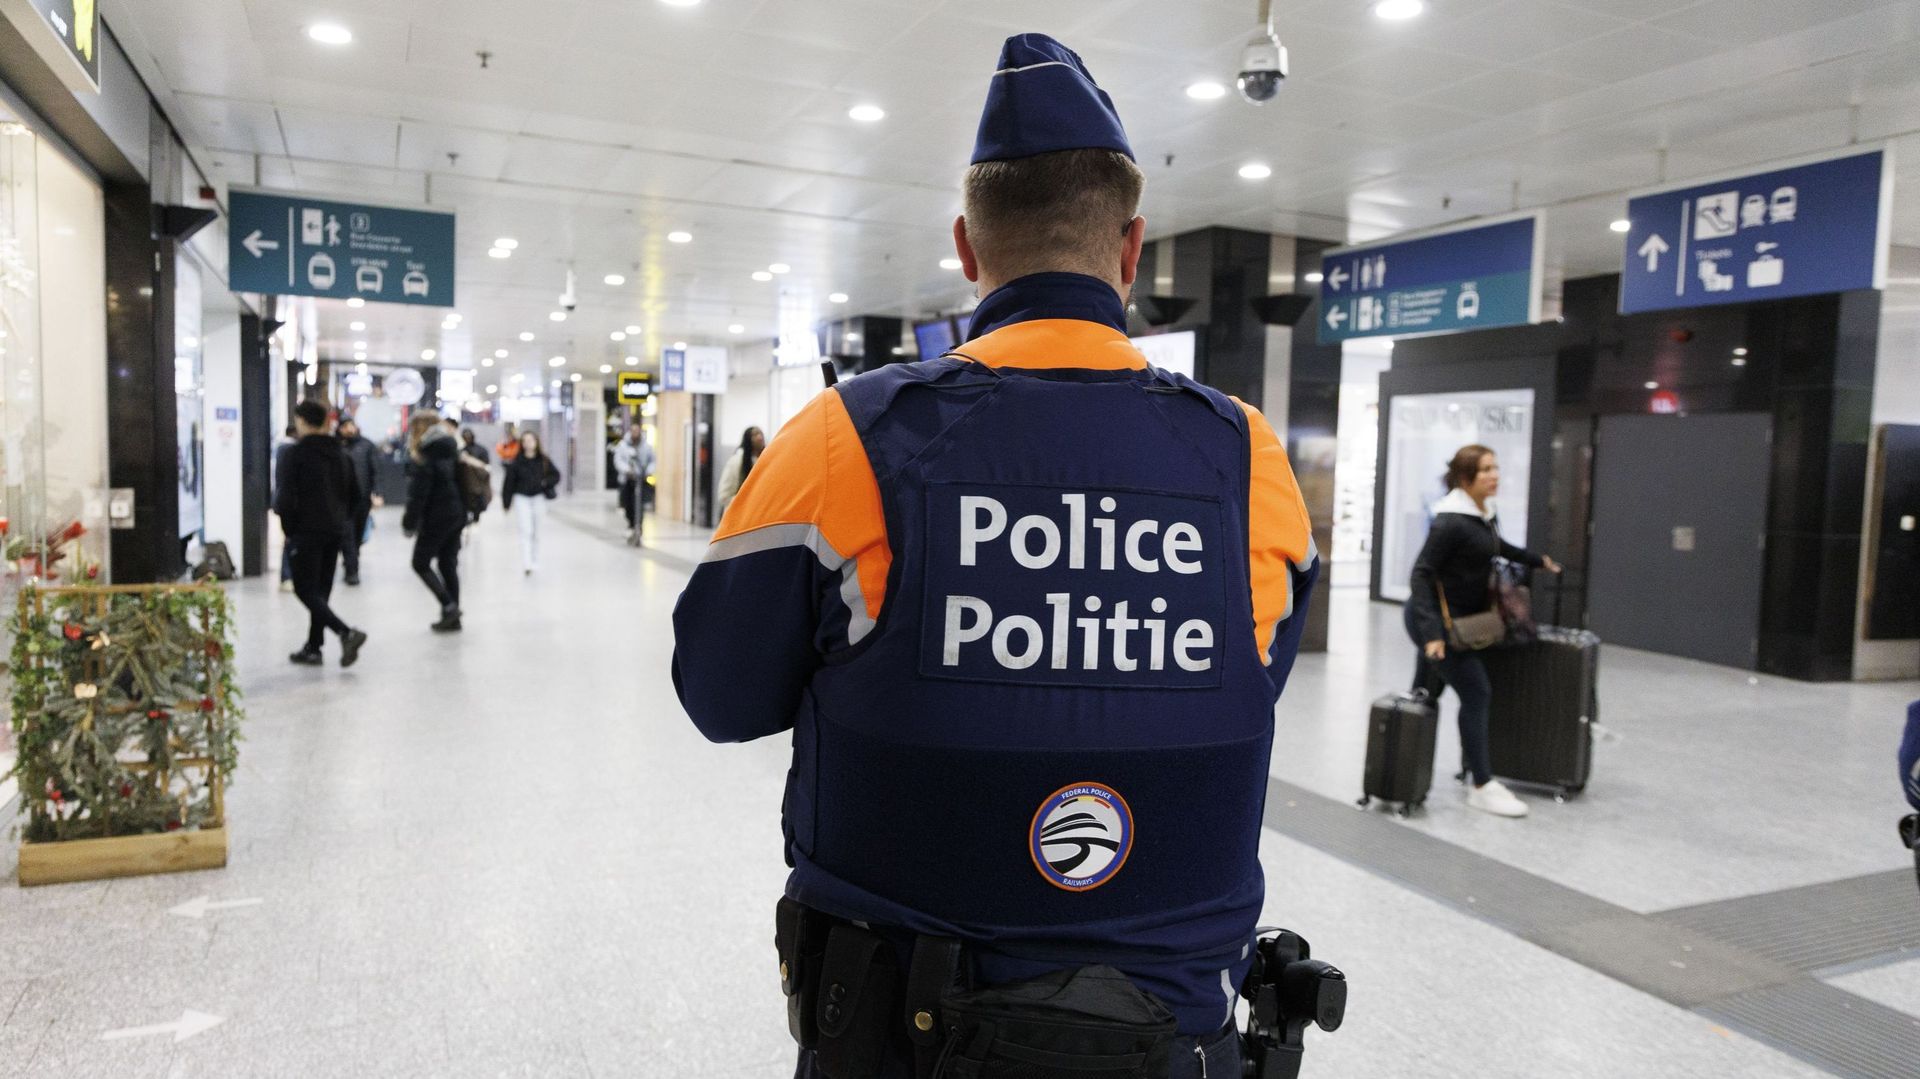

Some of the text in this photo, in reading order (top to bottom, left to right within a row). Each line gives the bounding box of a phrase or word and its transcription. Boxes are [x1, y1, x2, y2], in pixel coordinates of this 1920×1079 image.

[960, 494, 1203, 574] Police
[943, 593, 1214, 671] Politie
[1061, 788, 1112, 800] FEDERAL POLICE
[1063, 877, 1093, 886] RAILWAYS
